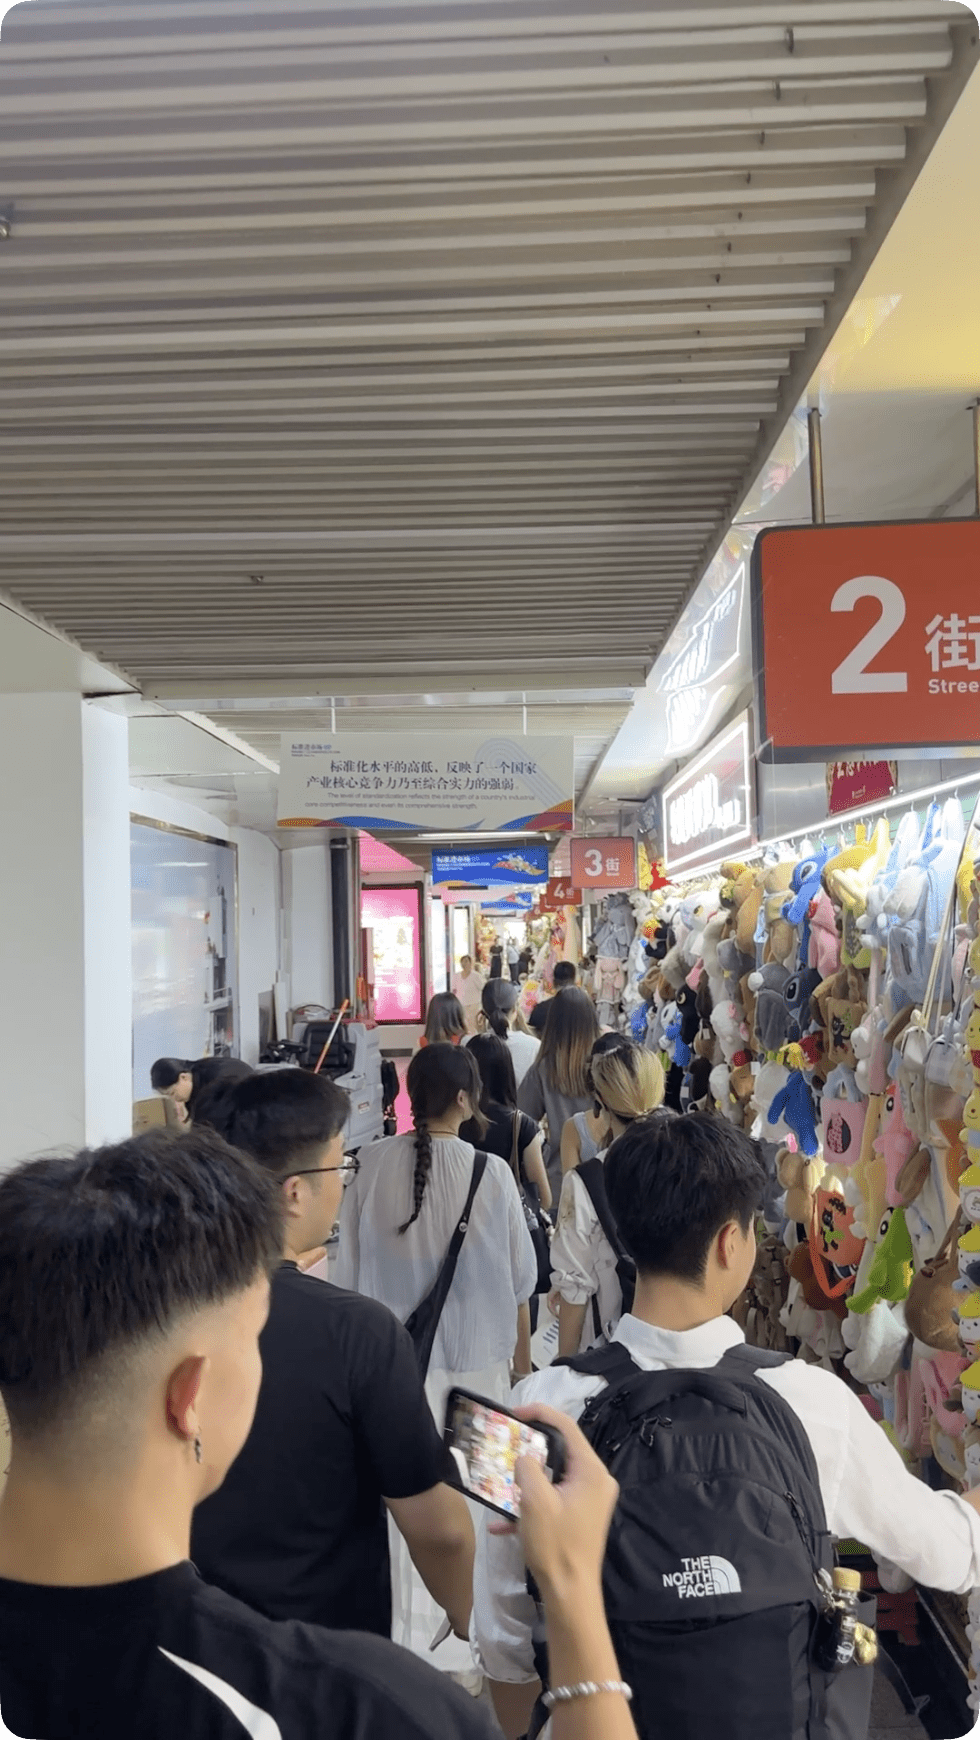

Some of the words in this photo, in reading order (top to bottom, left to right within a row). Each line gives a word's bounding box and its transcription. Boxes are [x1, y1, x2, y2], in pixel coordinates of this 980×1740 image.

[830, 575, 908, 694] 2
[928, 678, 980, 694] Stree
[408, 793, 430, 801] reflects
[442, 794, 468, 802] strength
[584, 849, 603, 877] 3
[553, 883, 565, 899] 4
[680, 1555, 711, 1571] THE
[662, 1568, 712, 1588] NORTH
[677, 1582, 715, 1599] FACE
